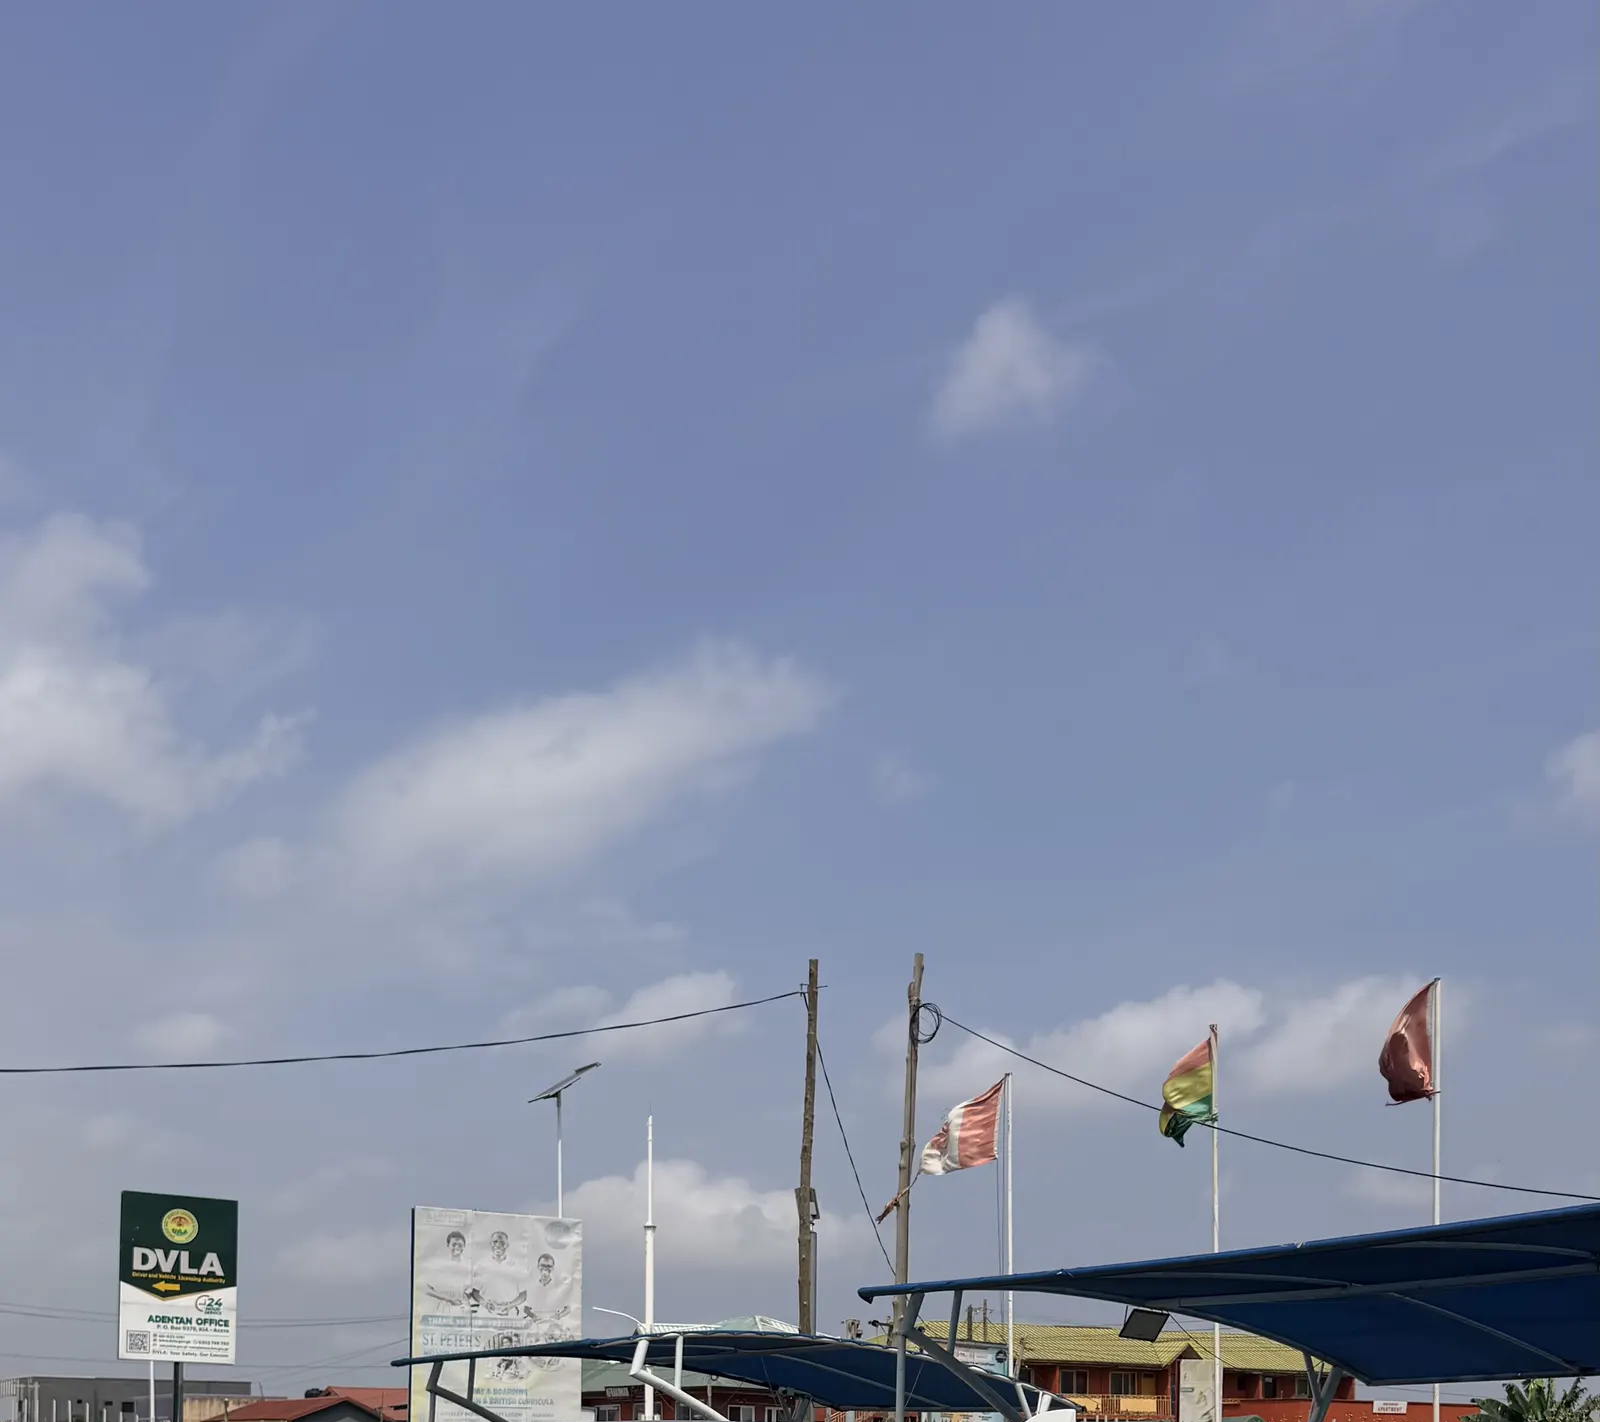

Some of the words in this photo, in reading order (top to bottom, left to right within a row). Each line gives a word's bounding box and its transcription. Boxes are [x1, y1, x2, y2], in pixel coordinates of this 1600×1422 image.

[133, 1246, 225, 1277] DVLA
[178, 1275, 201, 1283] Licensing
[206, 1298, 223, 1307] 24
[147, 1315, 192, 1325] ADENTAN
[196, 1317, 229, 1327] OFFICE
